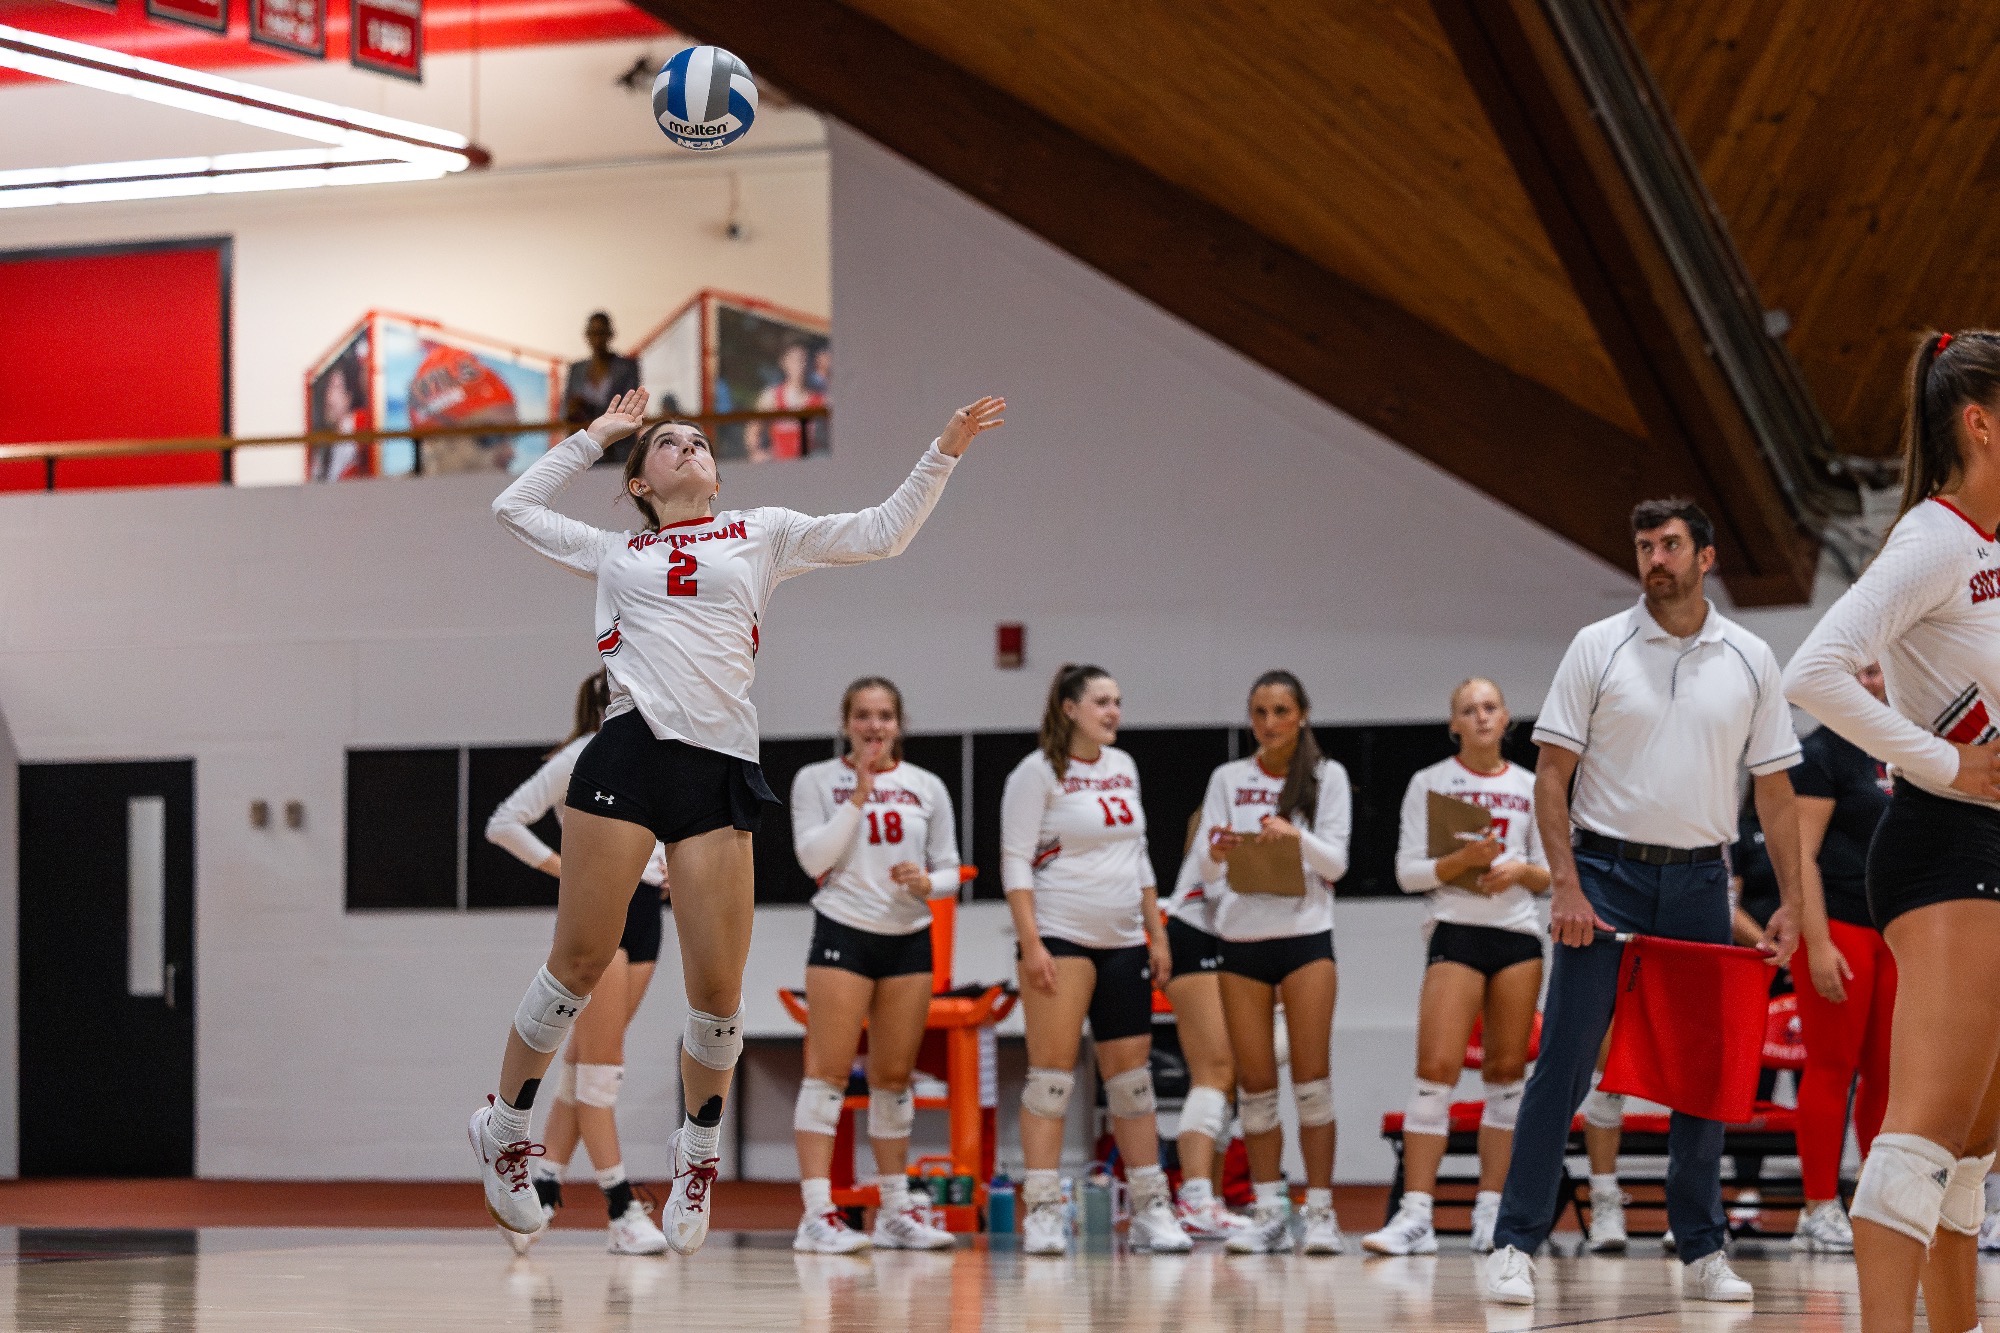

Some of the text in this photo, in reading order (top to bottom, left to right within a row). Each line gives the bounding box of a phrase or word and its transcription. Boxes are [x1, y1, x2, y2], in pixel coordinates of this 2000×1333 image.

[669, 121, 727, 136] molten
[677, 137, 724, 149] NCAA
[667, 549, 698, 597] 2
[1097, 795, 1135, 827] 13
[866, 810, 904, 846] 18
